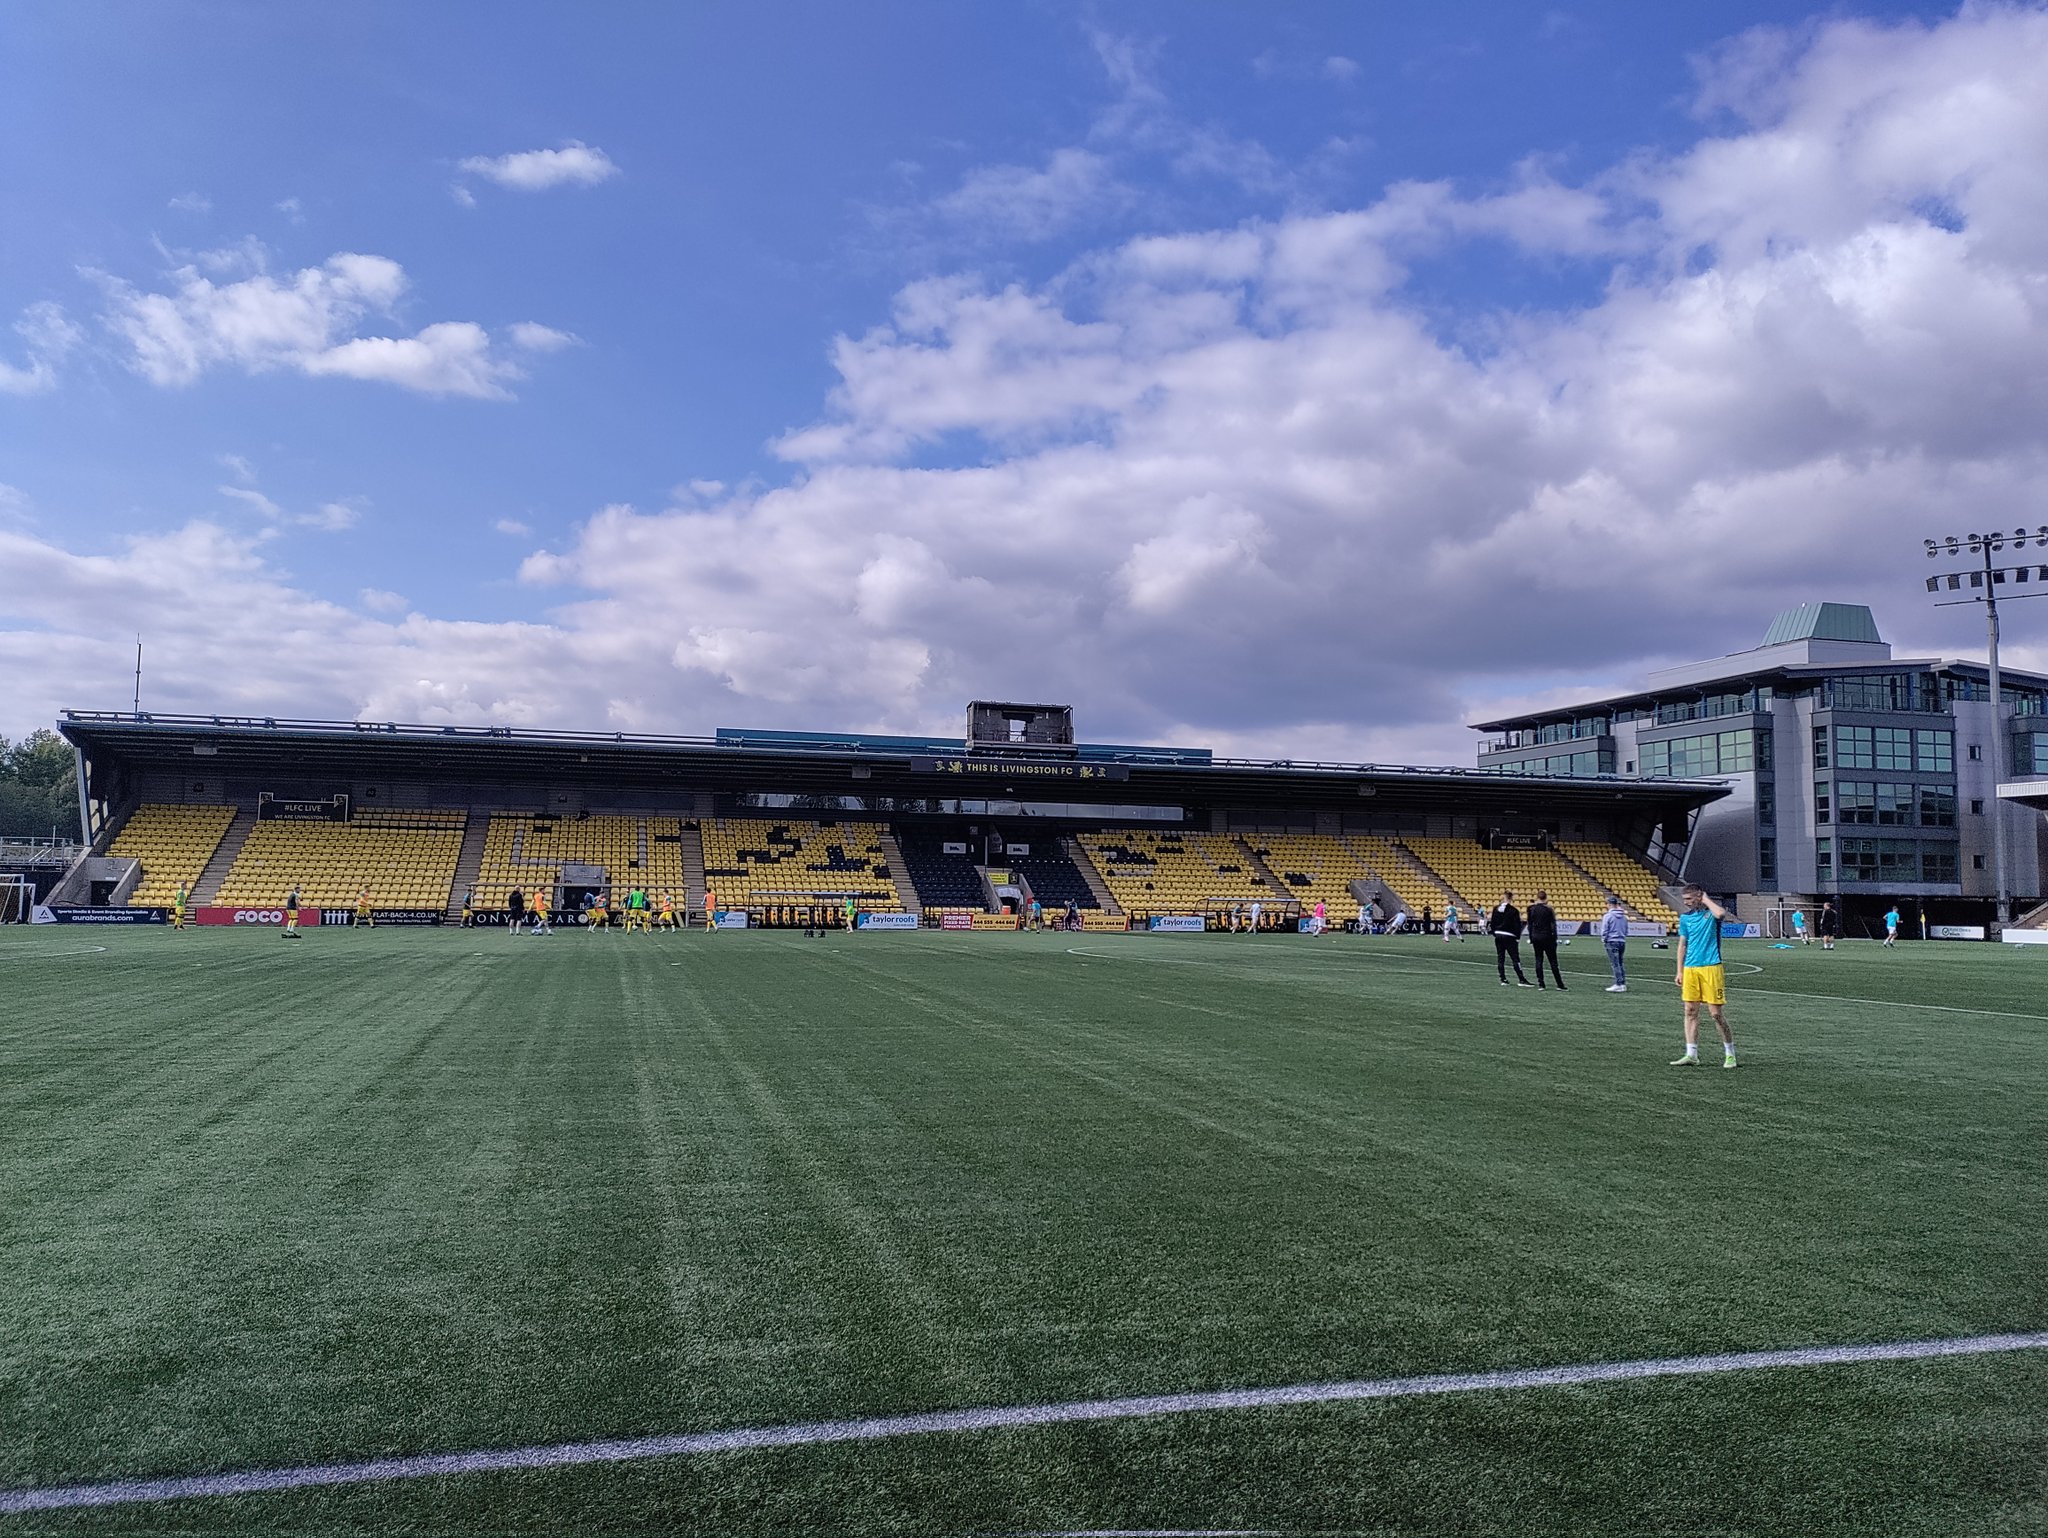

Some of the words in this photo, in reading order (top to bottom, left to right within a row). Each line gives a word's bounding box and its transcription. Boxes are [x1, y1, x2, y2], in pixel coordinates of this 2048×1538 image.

[967, 763, 988, 772] THIS
[990, 764, 998, 772] IS
[1001, 765, 1058, 775] LIVINGSTON
[1061, 766, 1073, 775] FC
[284, 804, 303, 812] #LFC
[233, 910, 283, 923] FOCO
[872, 915, 895, 924] taylor
[895, 915, 915, 923] roofs
[1163, 918, 1184, 927] taylor
